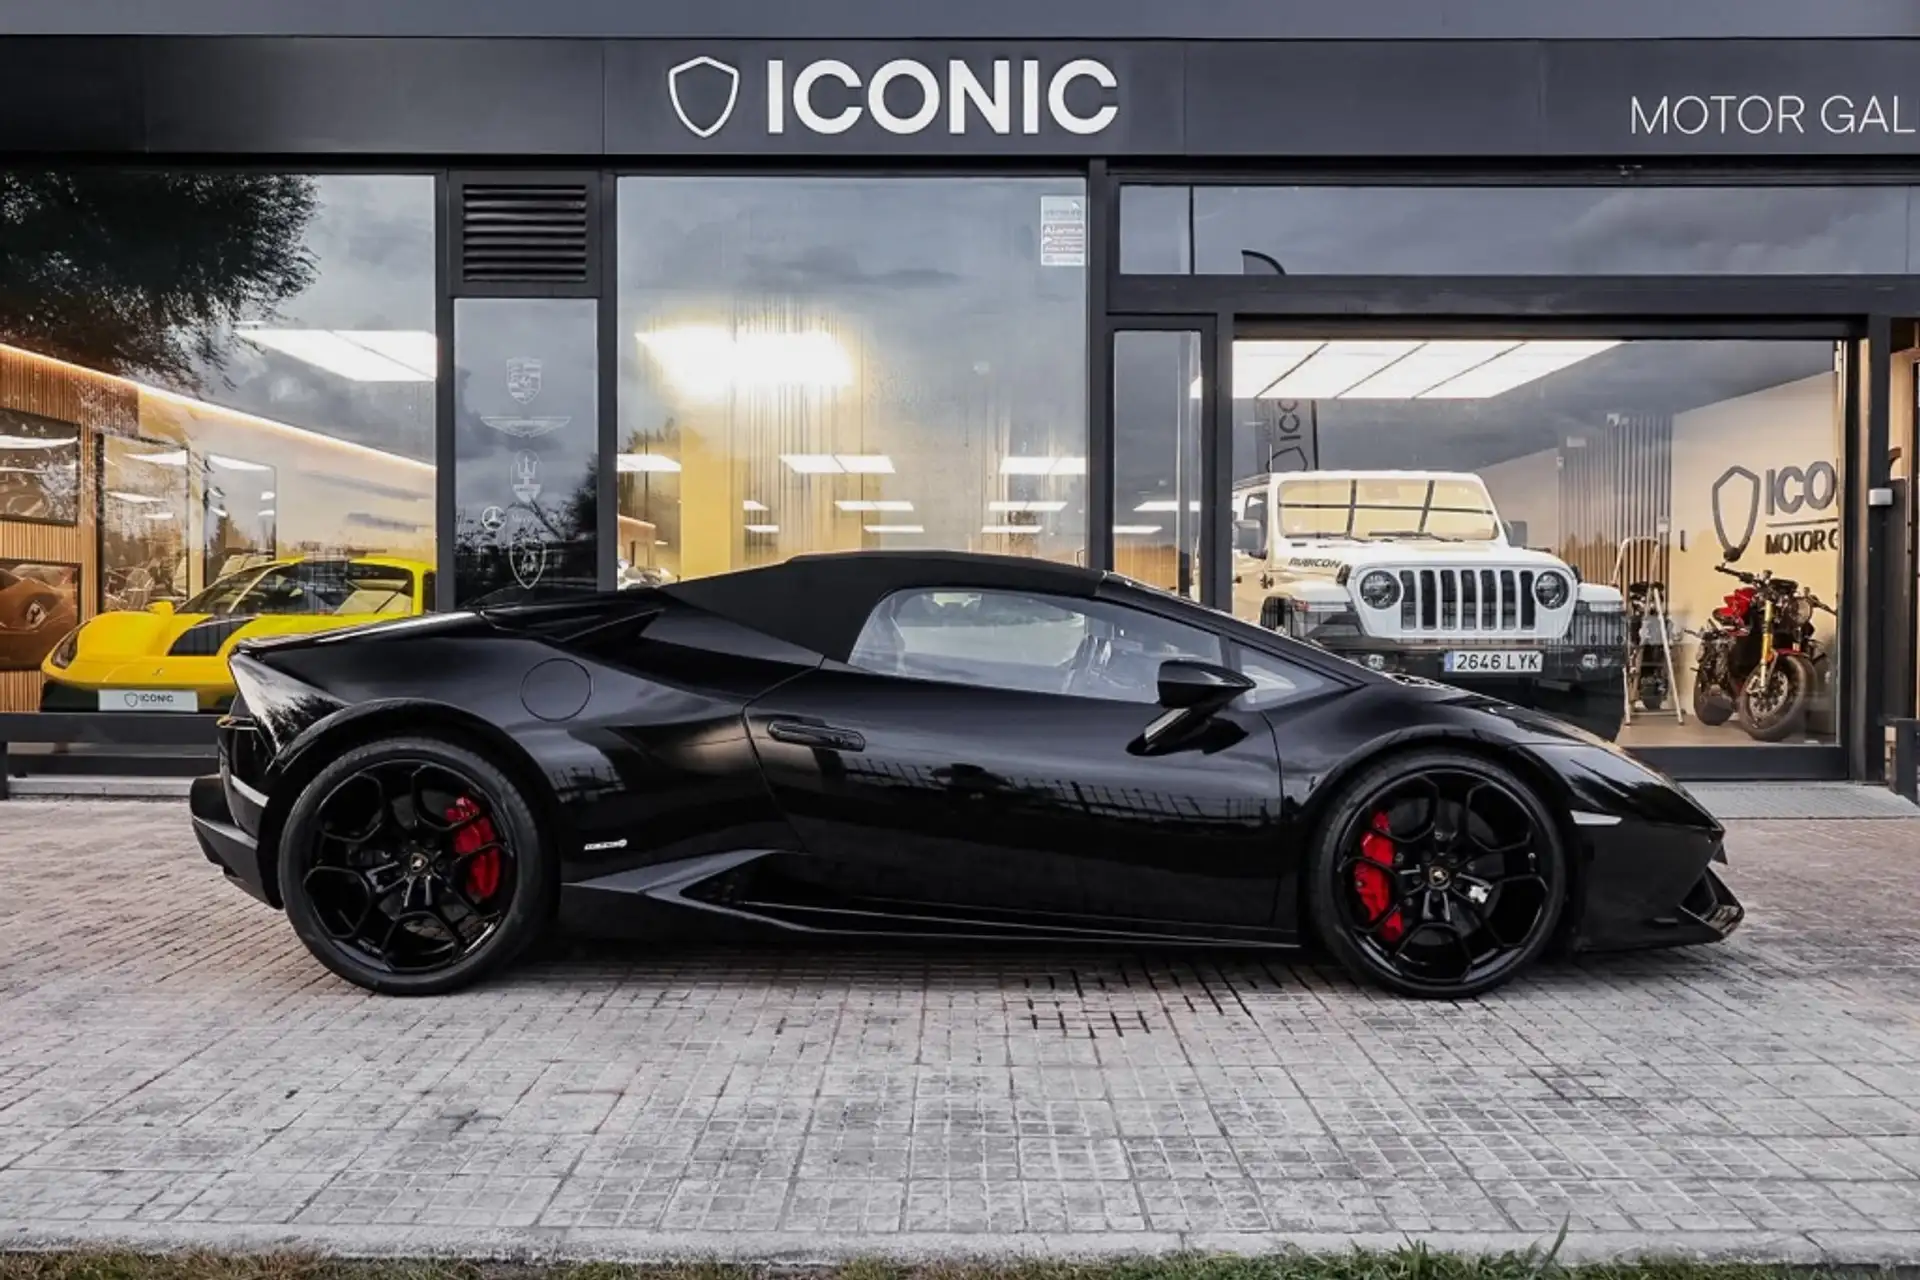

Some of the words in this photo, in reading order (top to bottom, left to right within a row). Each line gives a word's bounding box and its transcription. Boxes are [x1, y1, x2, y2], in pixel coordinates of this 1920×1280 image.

[767, 58, 1119, 135] ICONIC
[1631, 95, 1805, 134] MOTOR
[1820, 95, 1916, 134] GAL
[1765, 458, 1839, 516] ICO
[1765, 529, 1826, 555] MOTOR
[1457, 654, 1501, 670] 2646
[1506, 654, 1538, 670] LYK
